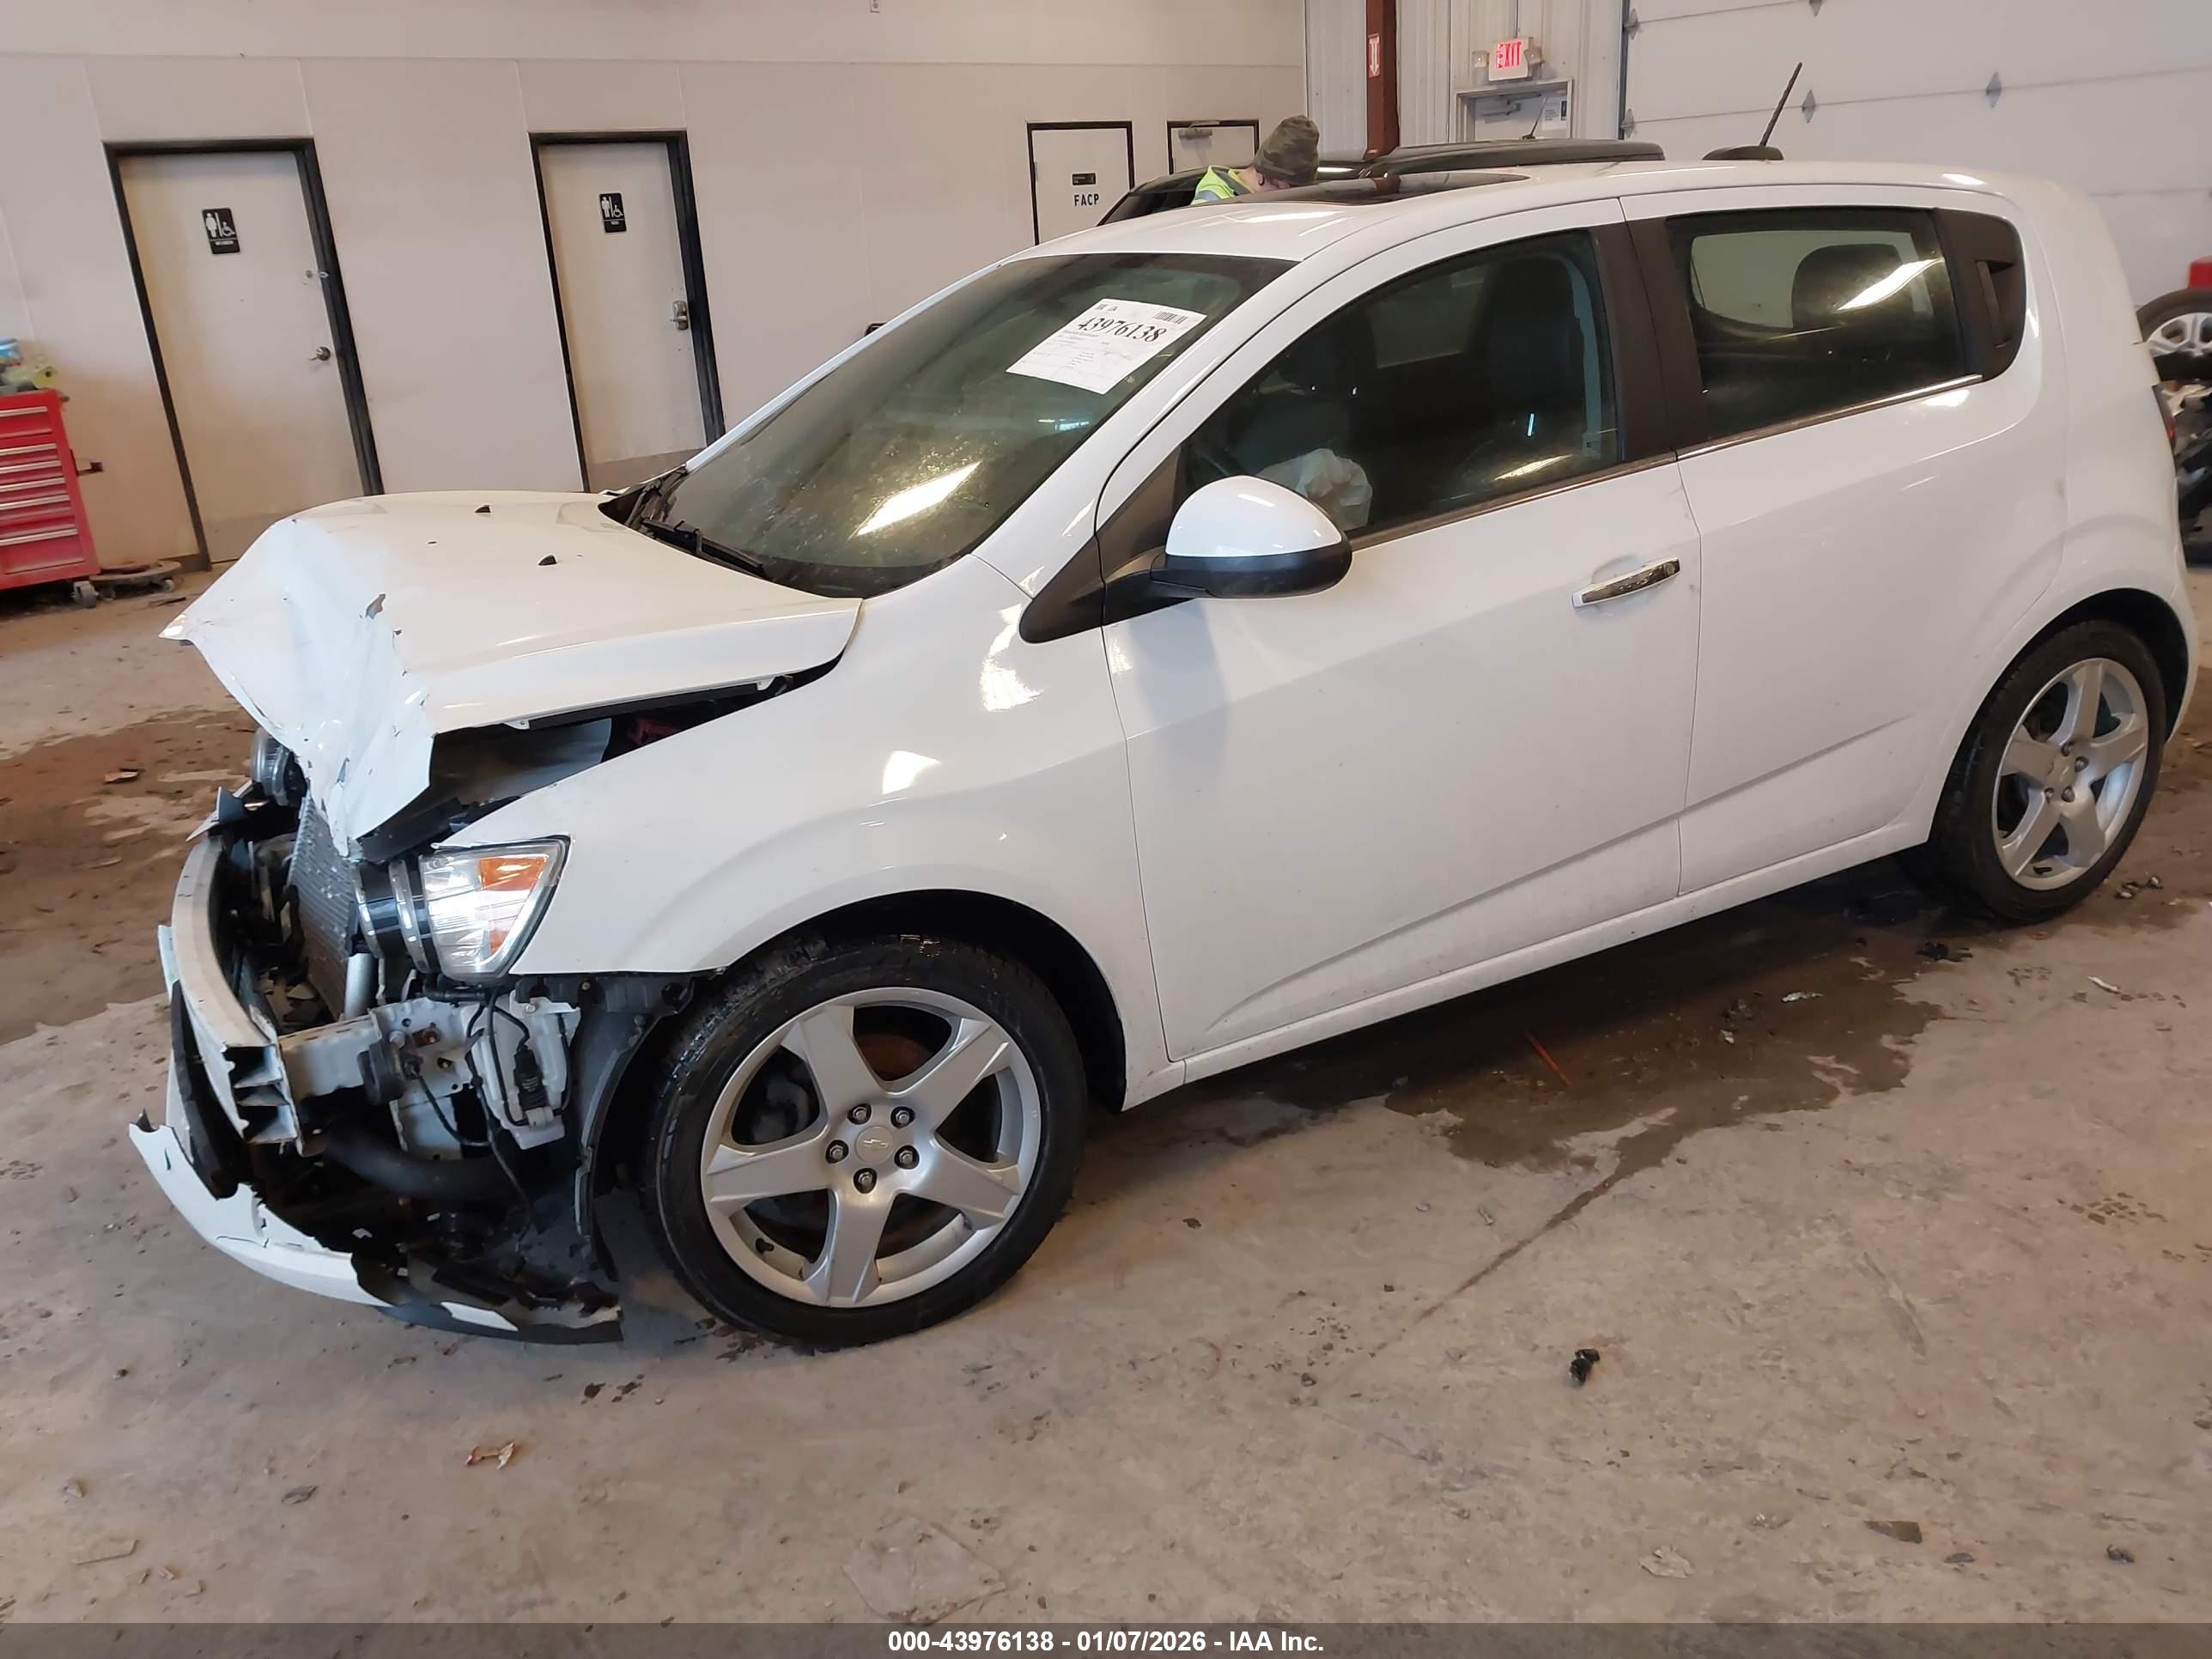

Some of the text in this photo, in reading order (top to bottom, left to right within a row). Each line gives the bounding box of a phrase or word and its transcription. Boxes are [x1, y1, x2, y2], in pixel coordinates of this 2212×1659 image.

[1497, 42, 1522, 69] EXIT
[1073, 193, 1100, 207] FACP
[1078, 316, 1167, 343] 43976138
